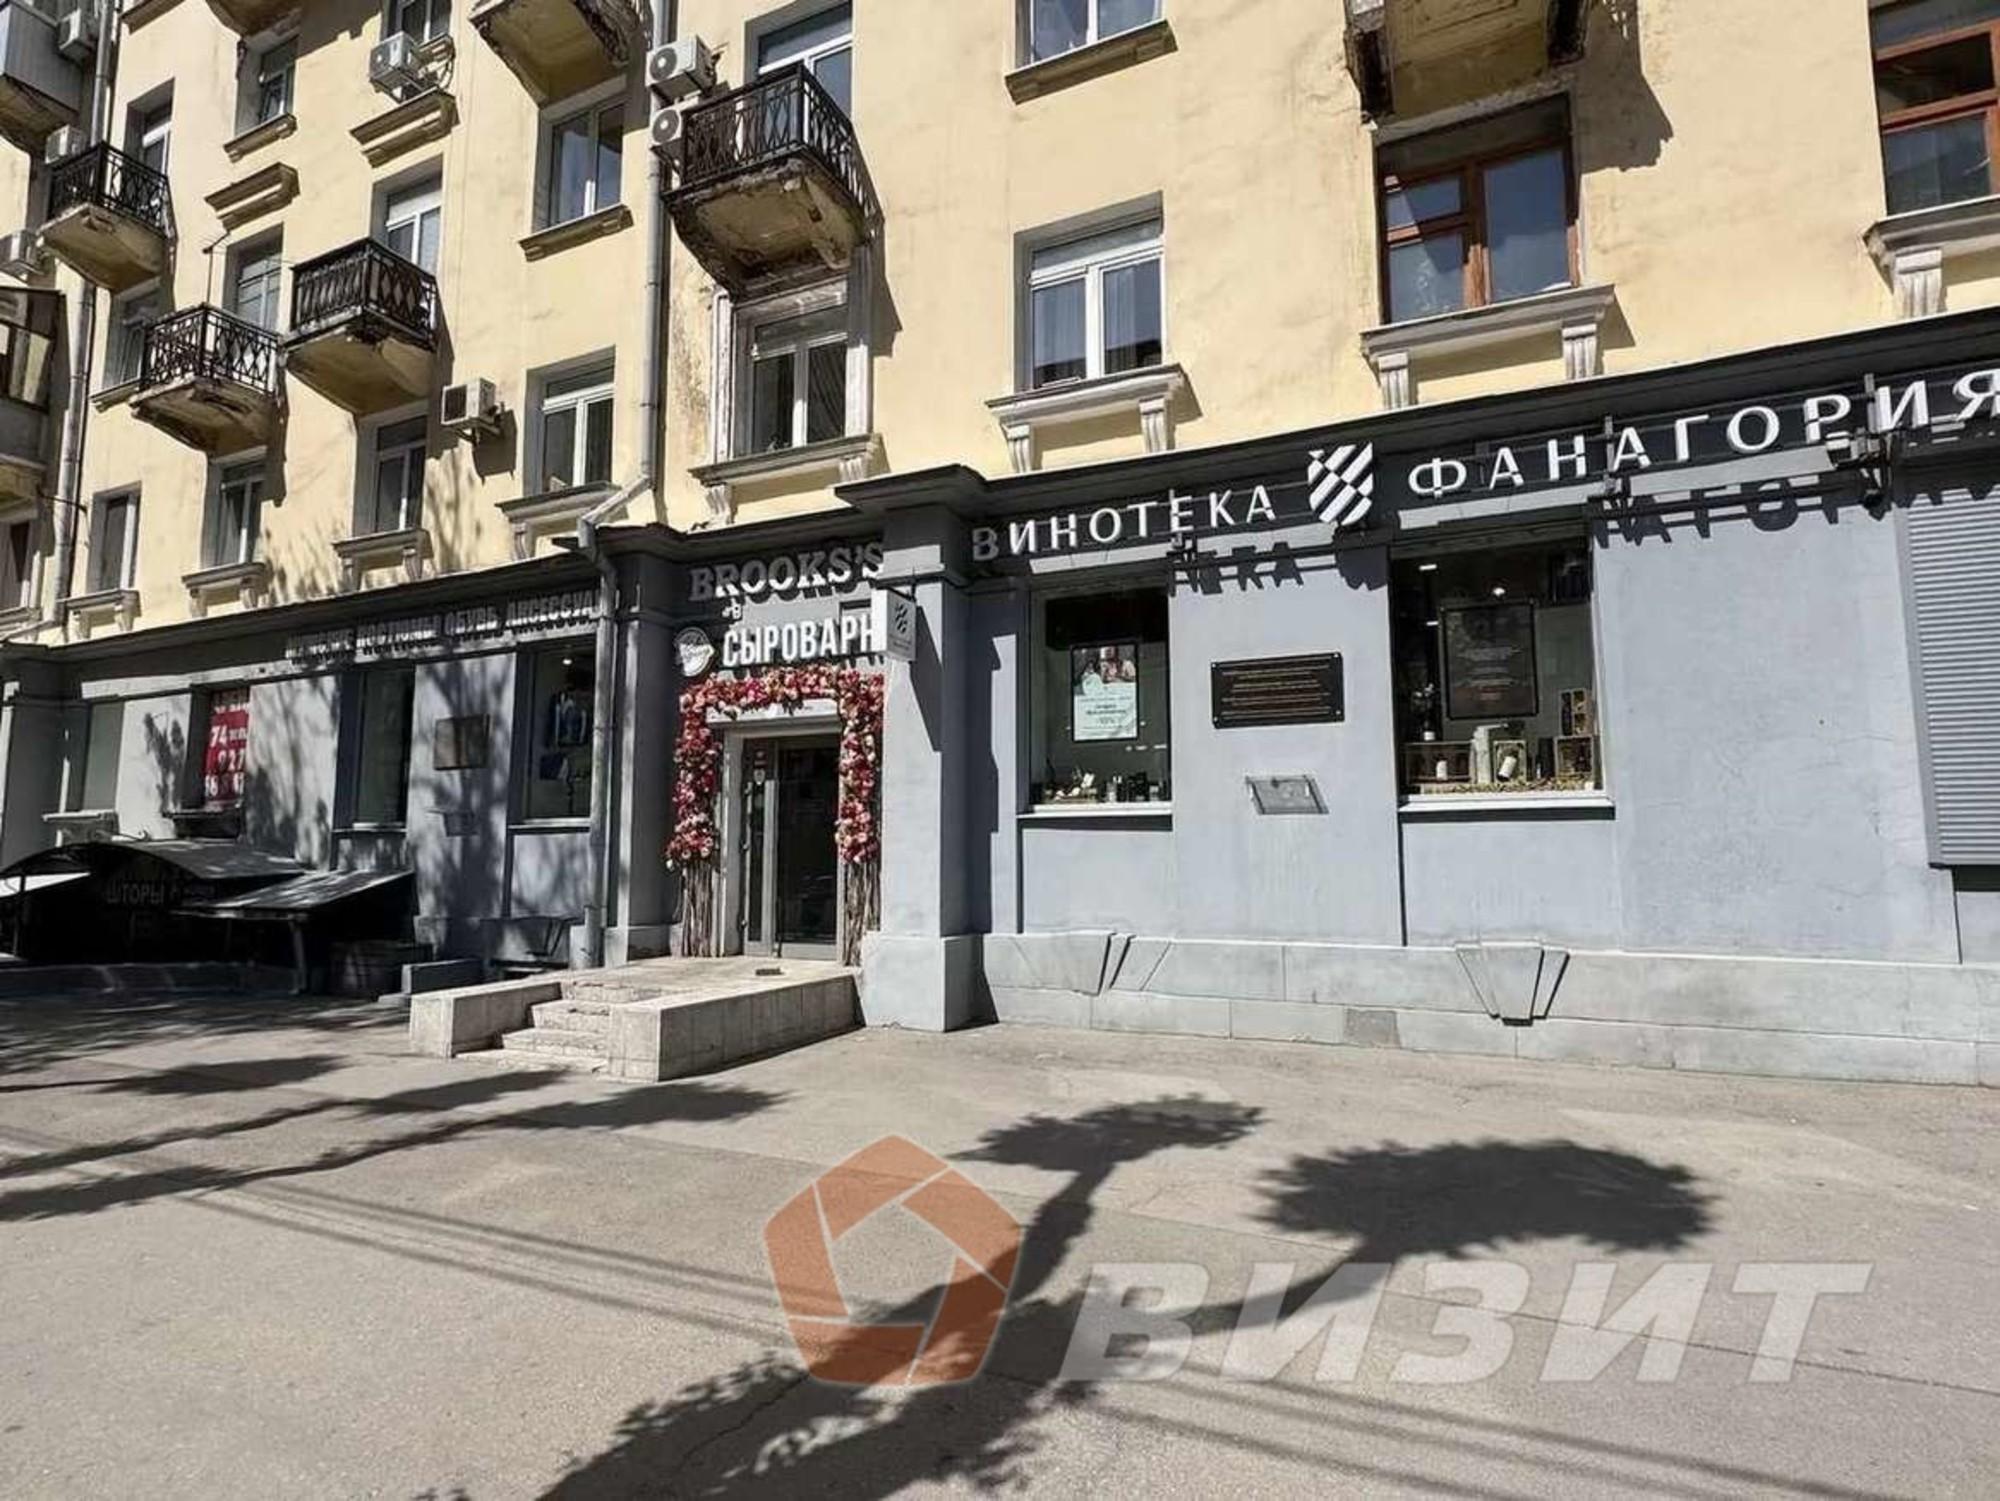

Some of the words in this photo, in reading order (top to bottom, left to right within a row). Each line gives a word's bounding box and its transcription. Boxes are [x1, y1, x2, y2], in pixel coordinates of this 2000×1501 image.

[973, 484, 1276, 562] ВИНОТЕКА
[1407, 368, 2000, 499] ФАНАГОРИЯ
[688, 541, 883, 601] BROOKS'S
[506, 590, 600, 628] АКСЕССУА
[722, 612, 872, 668] СЫРОВАРН
